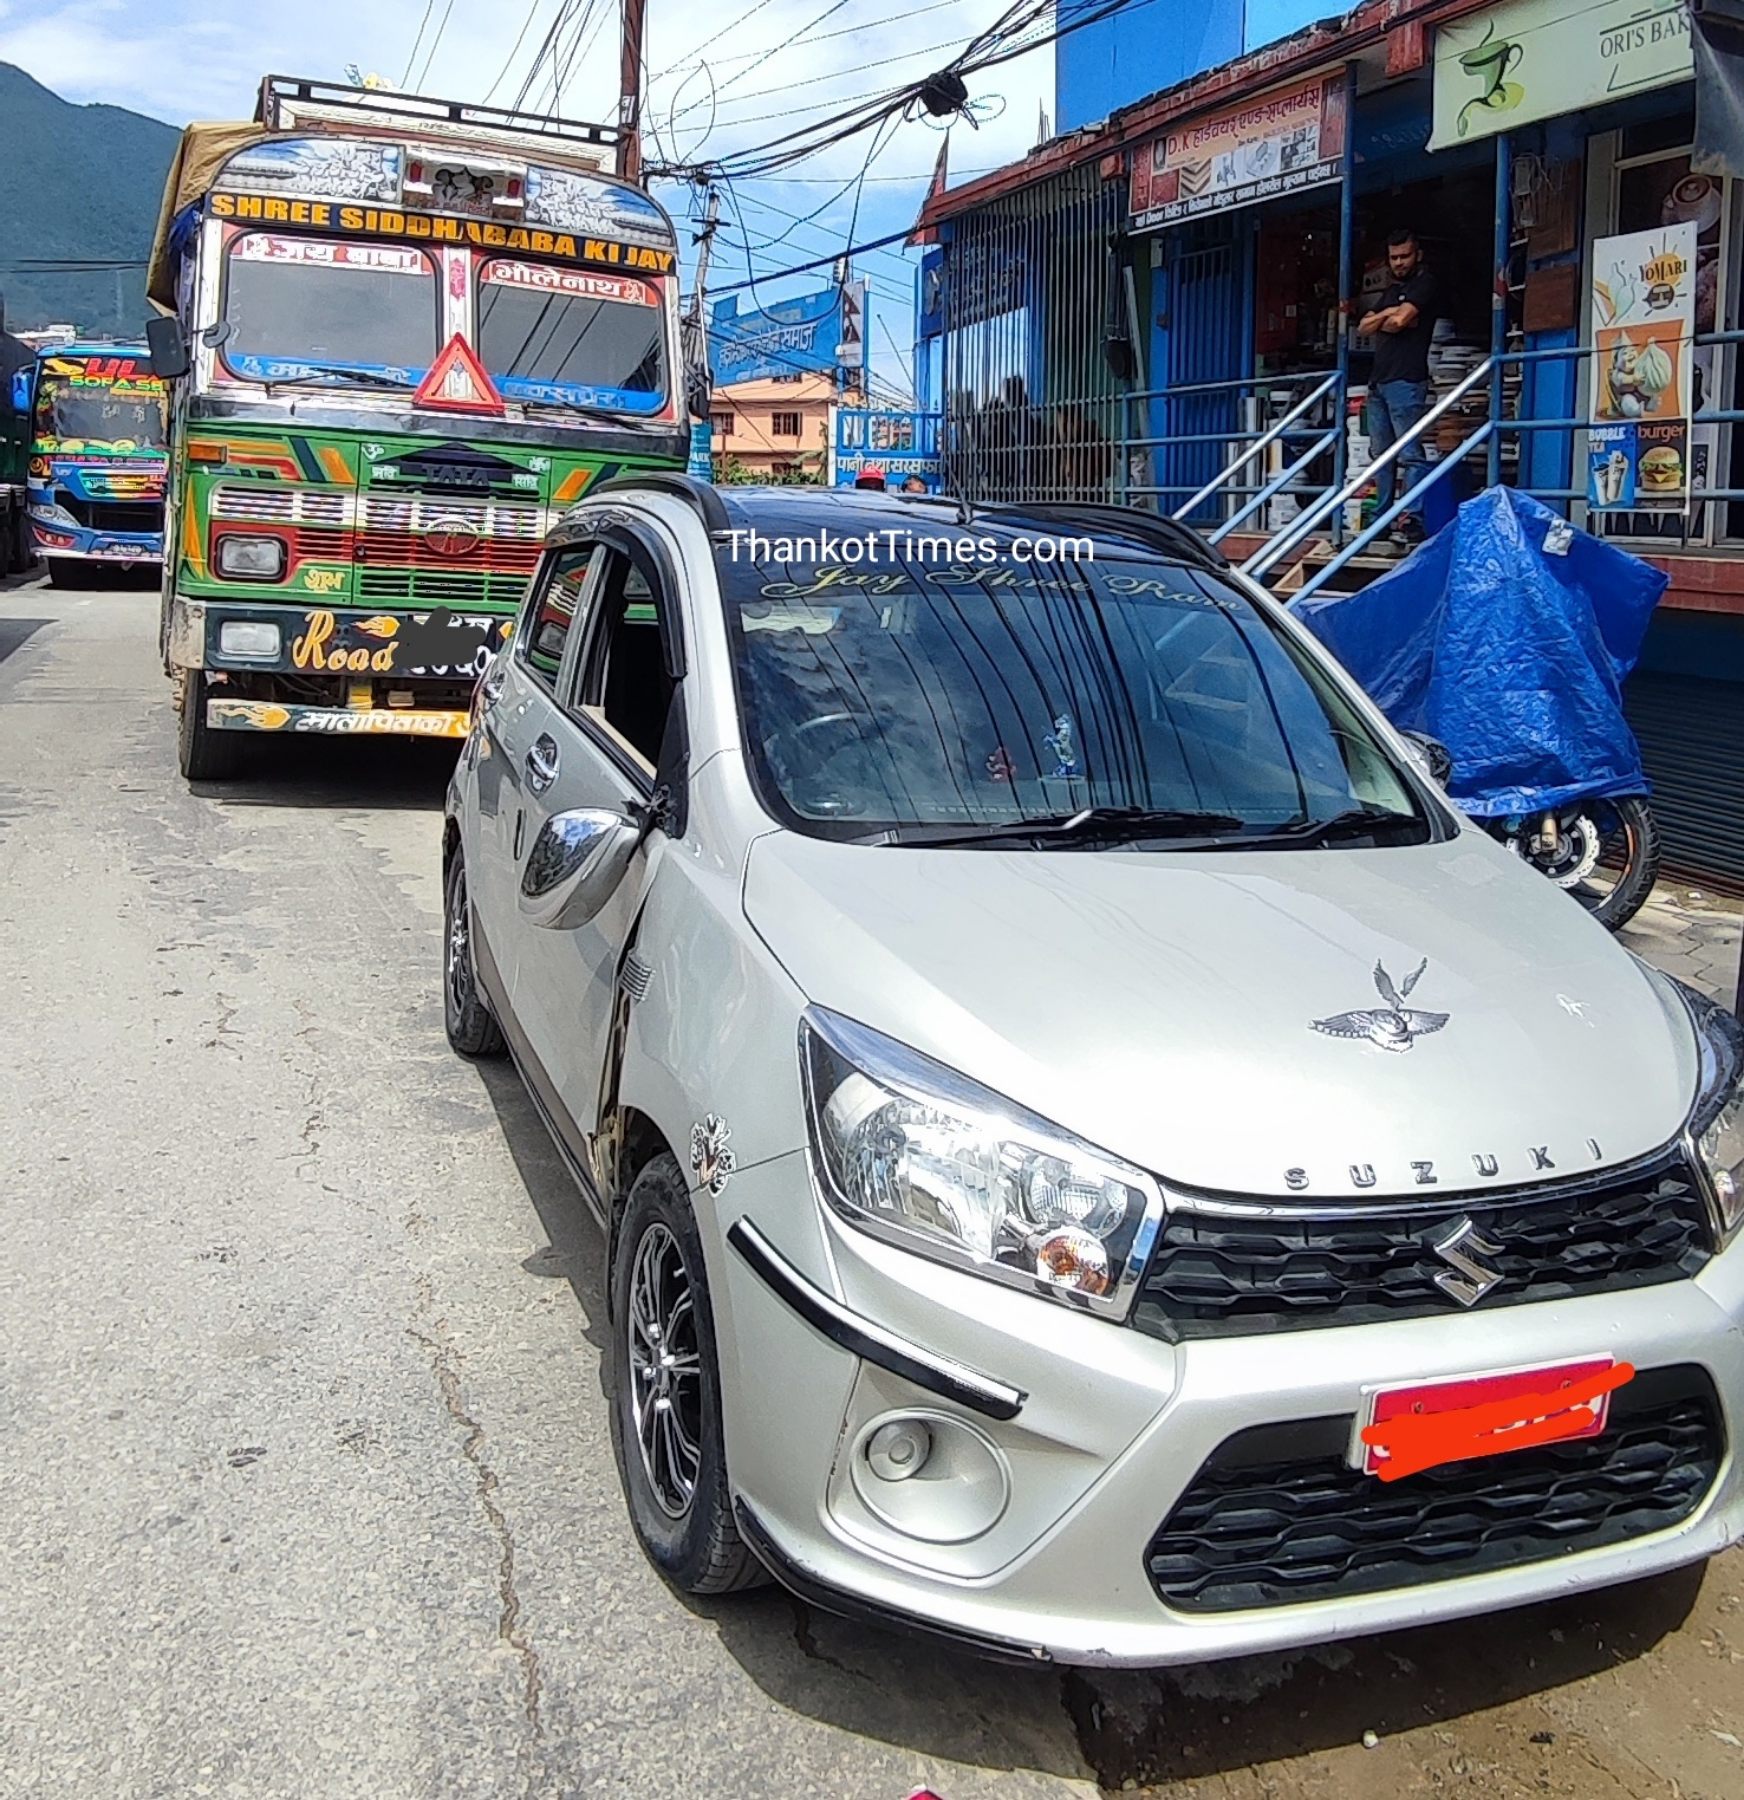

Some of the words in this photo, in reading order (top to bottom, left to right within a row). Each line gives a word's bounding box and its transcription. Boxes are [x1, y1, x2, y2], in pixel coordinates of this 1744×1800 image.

[1601, 27, 1645, 58] ORI'S
[211, 195, 331, 226] SHREE
[340, 207, 576, 258] SIDDHABABA
[584, 240, 620, 264] KI
[624, 247, 674, 272] JAY
[1638, 425, 1686, 443] burger
[422, 464, 490, 487] TATA
[761, 564, 912, 598] Jay
[1101, 572, 1243, 611] Ram
[293, 610, 400, 672] Road
[1284, 1138, 1603, 1191] SUZUKI
